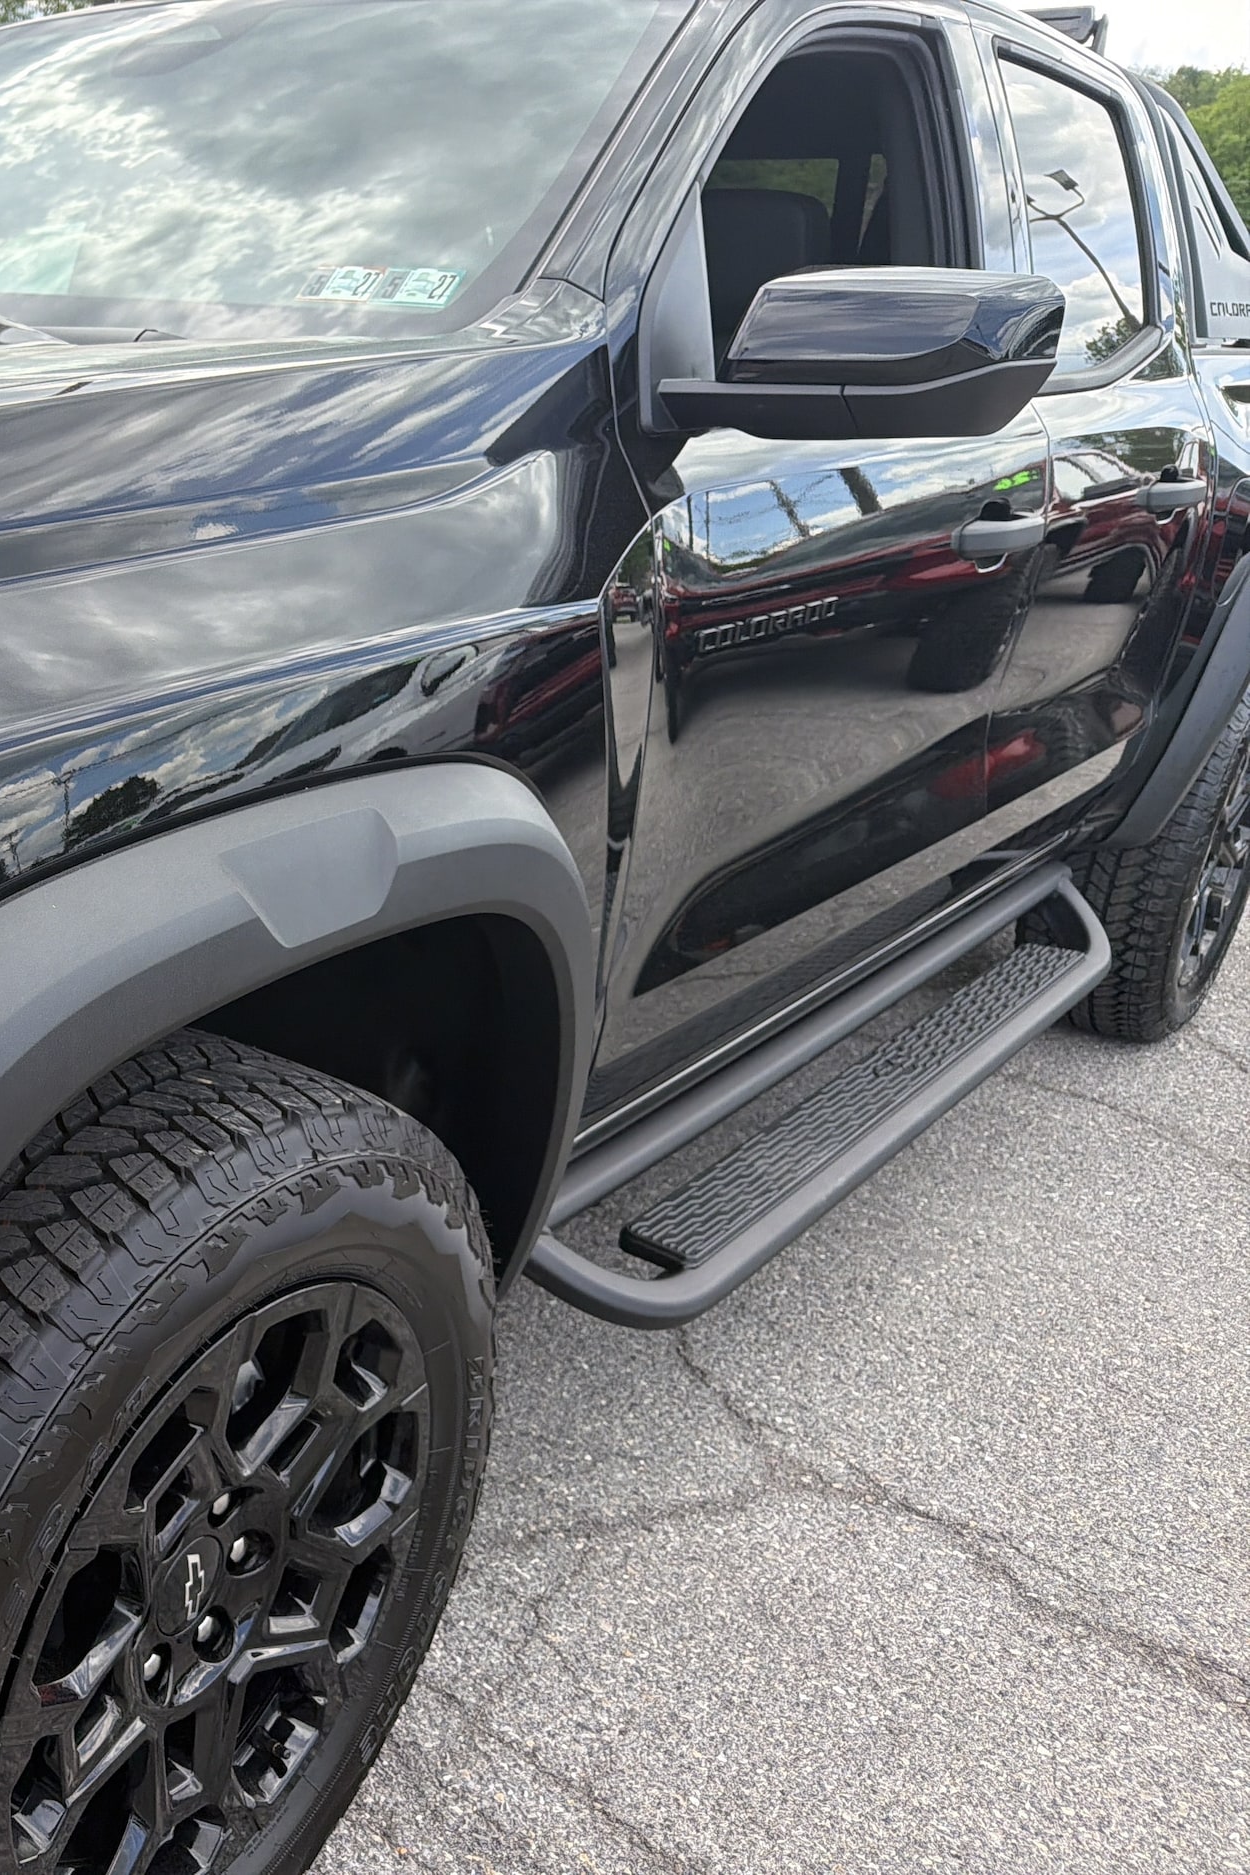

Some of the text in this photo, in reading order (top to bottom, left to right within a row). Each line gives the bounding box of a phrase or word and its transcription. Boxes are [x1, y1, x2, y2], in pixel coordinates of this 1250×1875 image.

[352, 272, 381, 297] 27
[428, 274, 457, 300] 27
[698, 596, 839, 651] COLORADO
